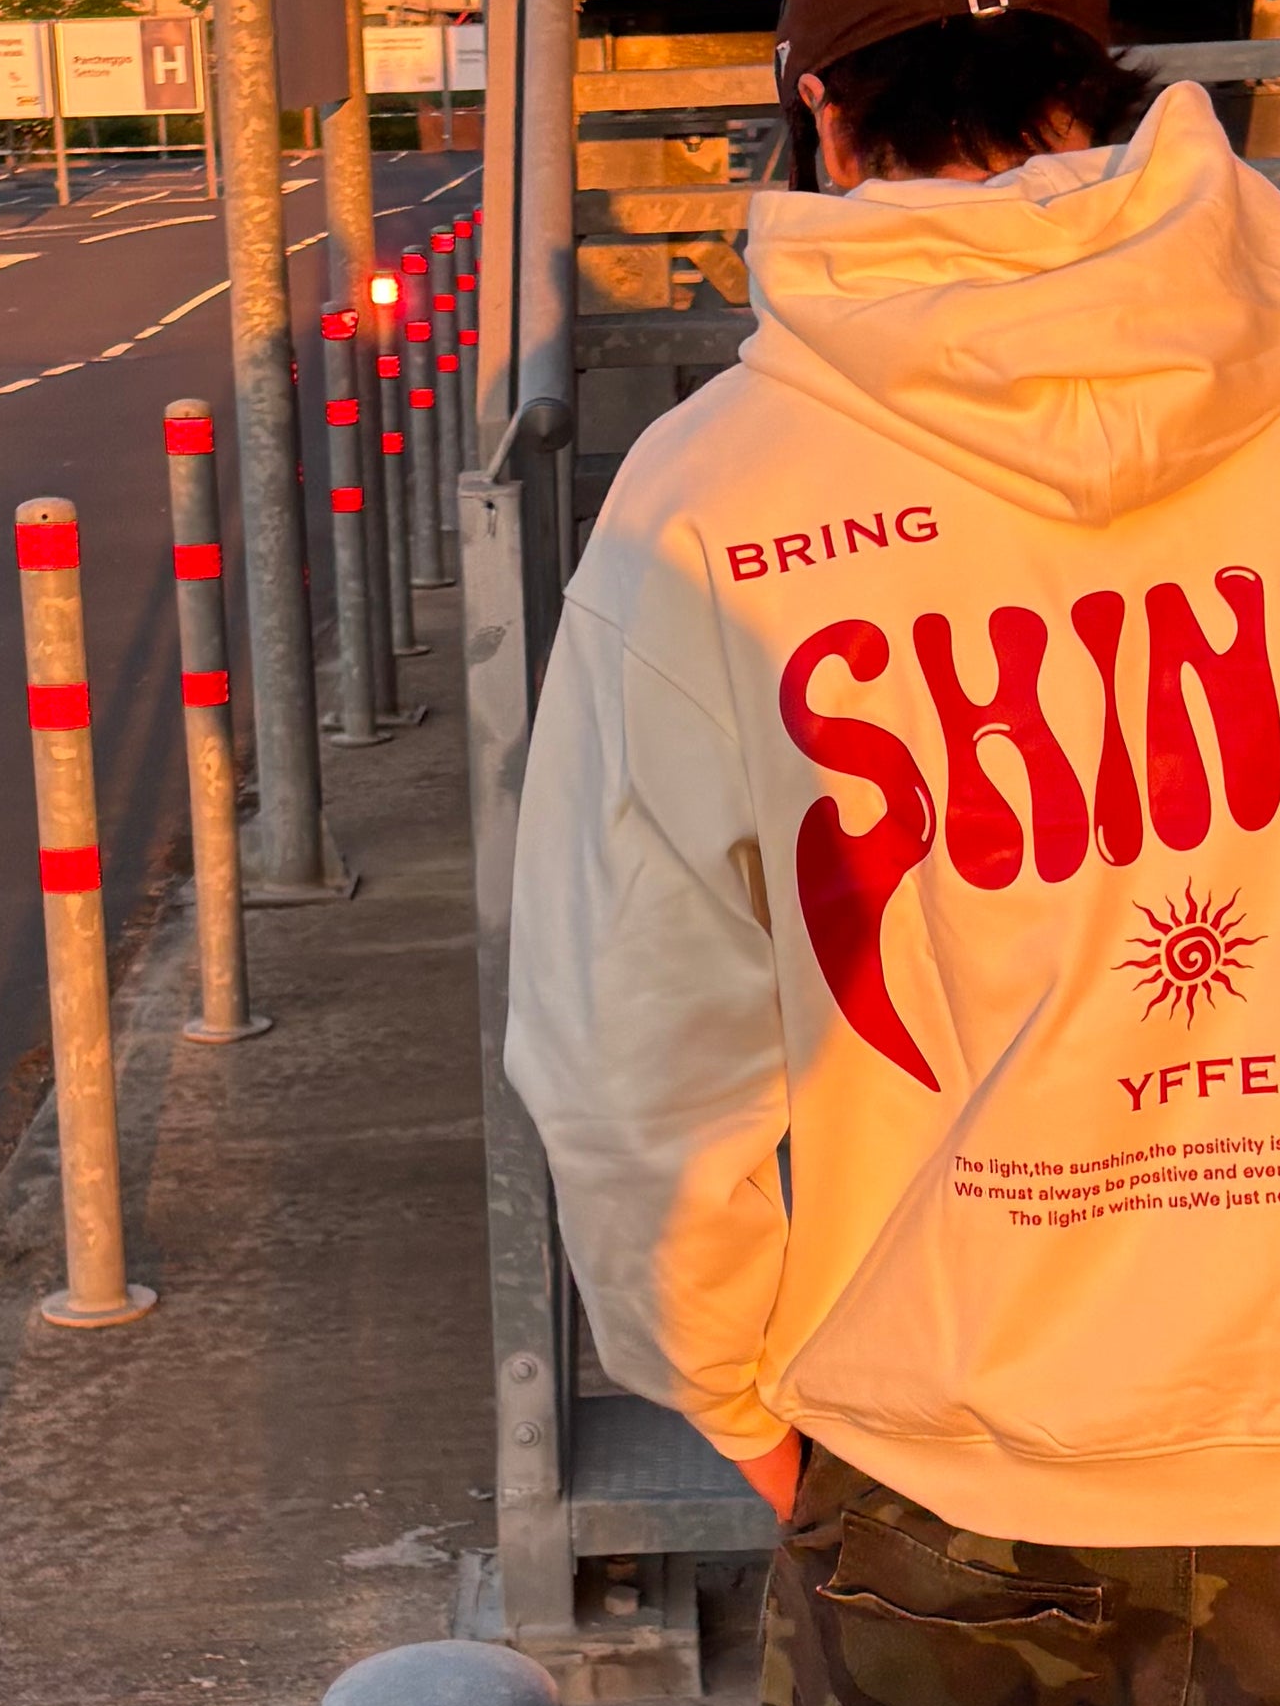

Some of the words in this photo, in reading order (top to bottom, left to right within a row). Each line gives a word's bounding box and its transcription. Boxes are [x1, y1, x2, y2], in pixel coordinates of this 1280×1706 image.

[152, 45, 188, 85] H
[725, 505, 941, 582] BRING
[1118, 1054, 1280, 1112] YFFE
[954, 1155, 984, 1173] The
[1182, 1136, 1264, 1159] positivity
[954, 1181, 983, 1197] We
[987, 1186, 1034, 1200] must
[1038, 1184, 1101, 1202] always
[1105, 1178, 1126, 1193] be
[1129, 1166, 1199, 1190] positive
[1203, 1164, 1238, 1181] and
[1009, 1210, 1043, 1227] The
[1047, 1207, 1088, 1228] light
[1091, 1204, 1105, 1219] is
[1108, 1193, 1164, 1215] within
[1225, 1189, 1260, 1210] just
